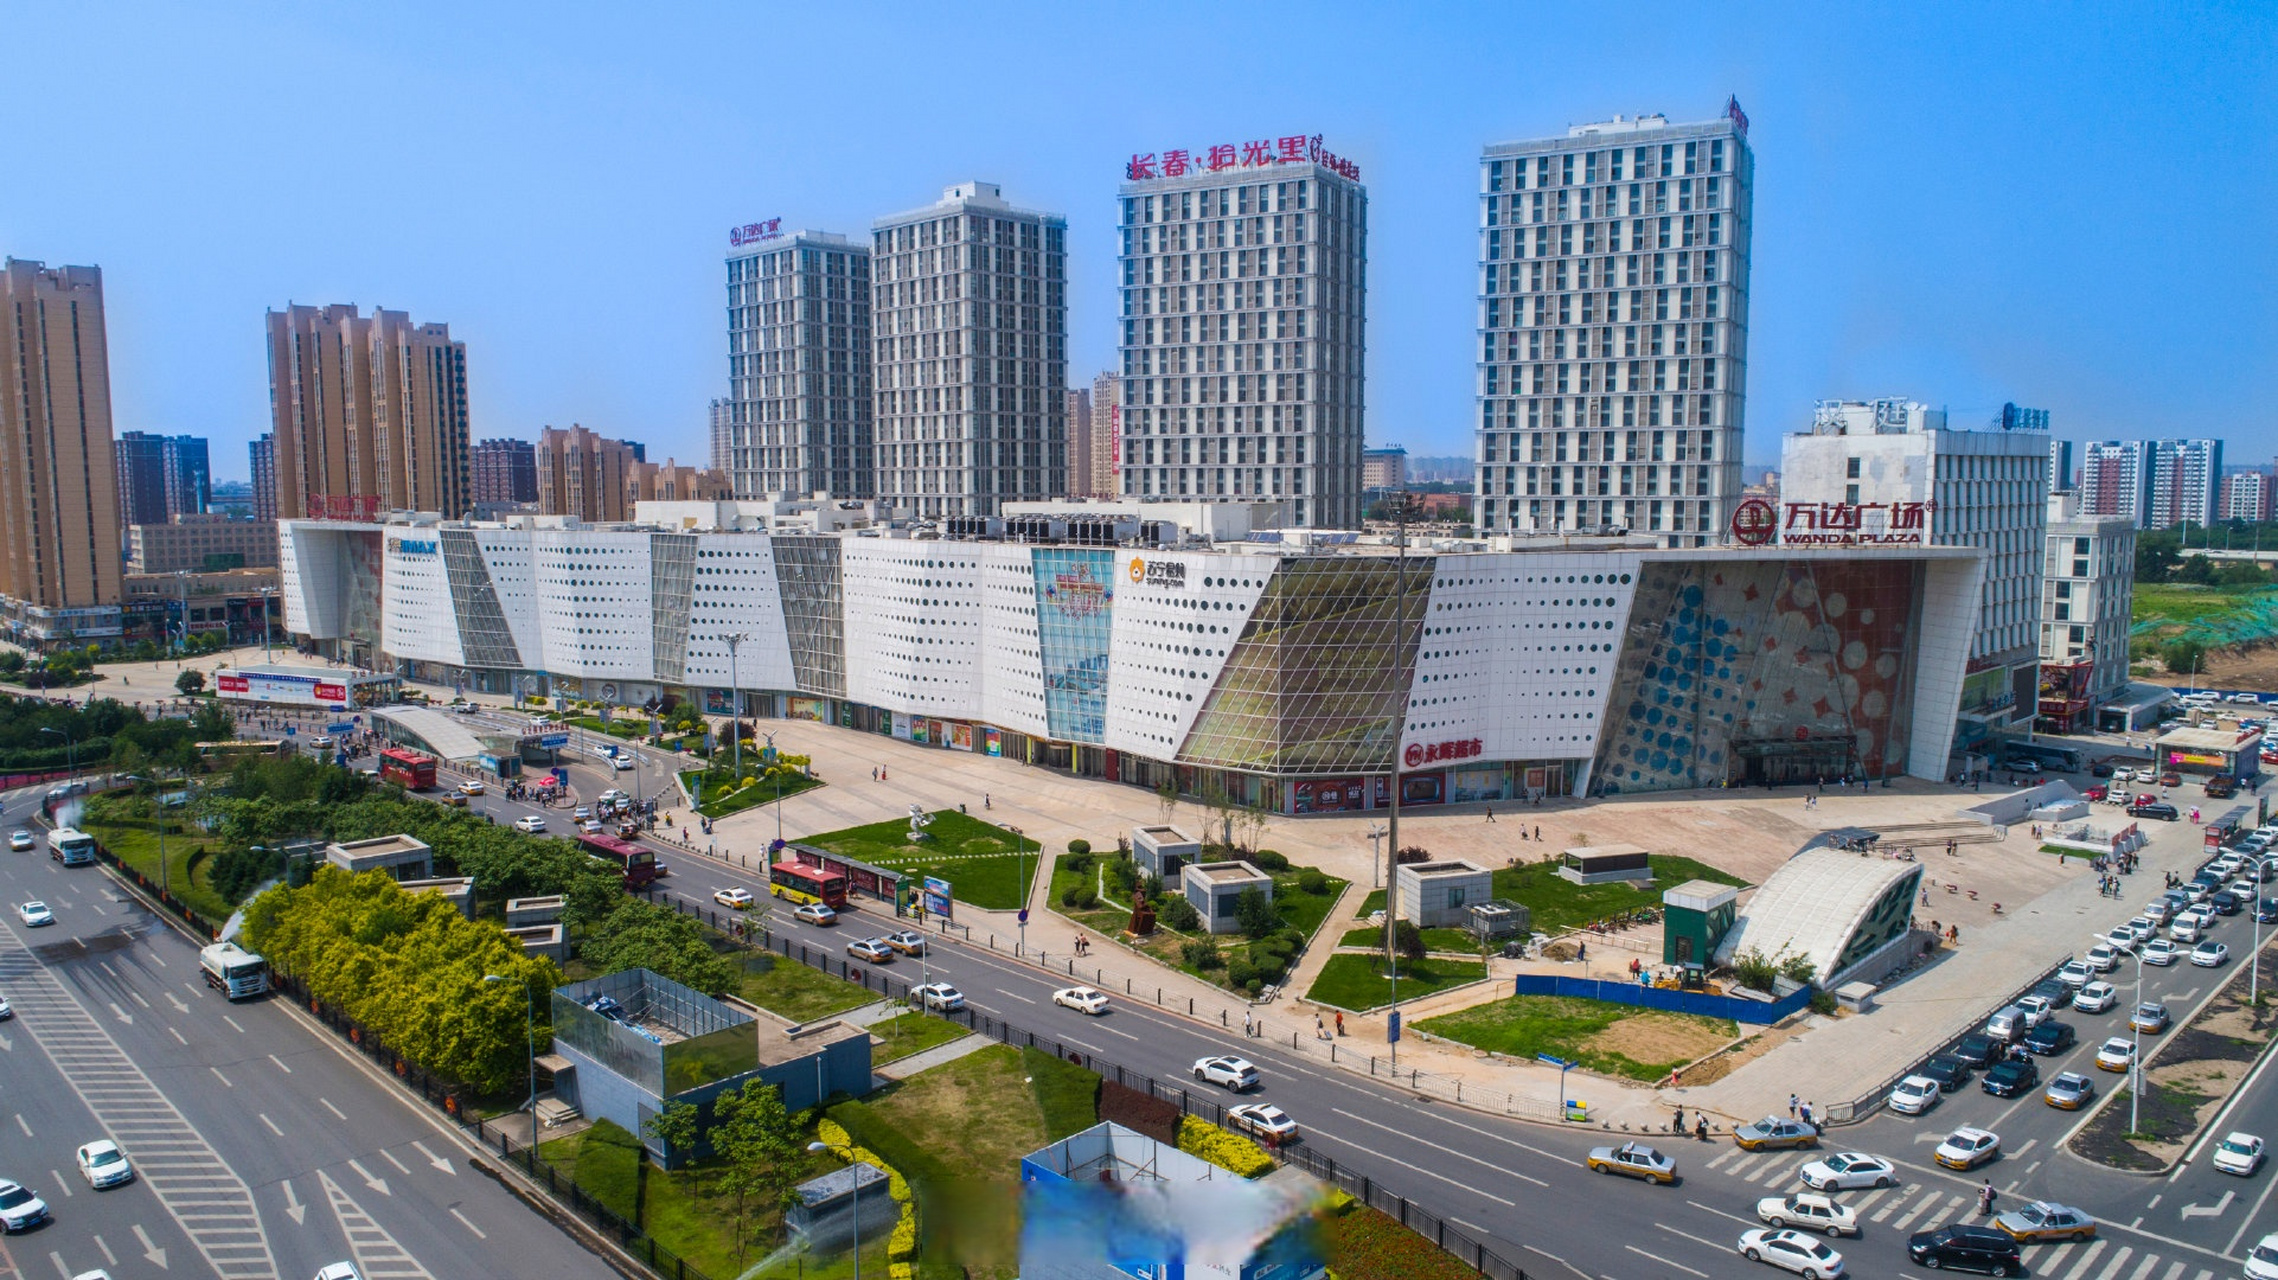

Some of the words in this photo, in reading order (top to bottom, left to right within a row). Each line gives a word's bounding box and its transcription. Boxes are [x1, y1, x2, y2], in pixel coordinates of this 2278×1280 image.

[1784, 502, 1924, 530] 万达广场
[401, 539, 436, 554] IMAX
[1784, 533, 1854, 544] WANDA
[1858, 533, 1921, 544] PLAZA
[1424, 737, 1483, 763] 永辉超市
